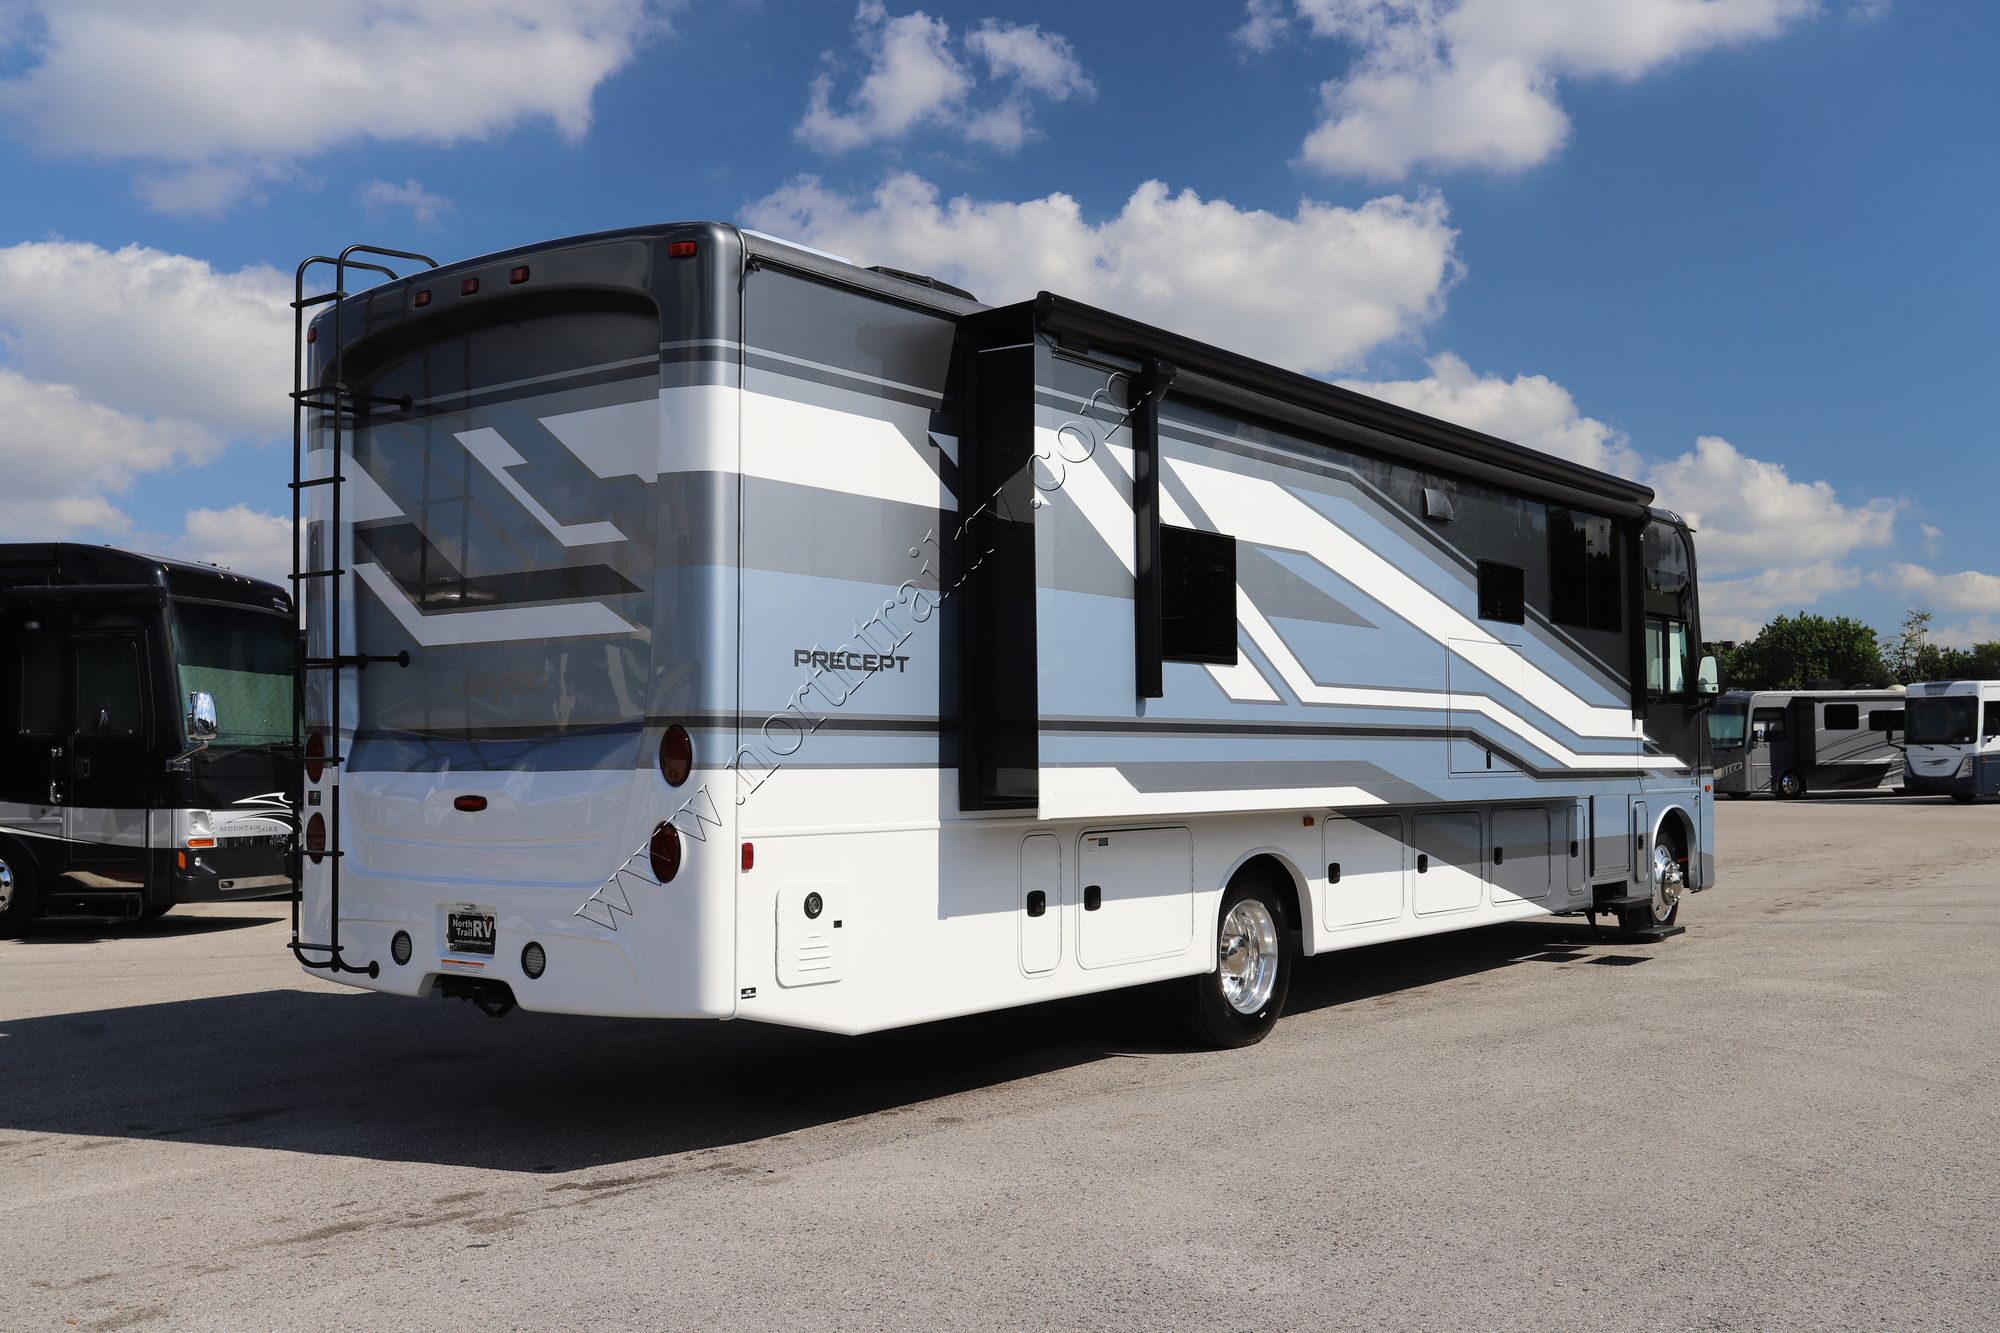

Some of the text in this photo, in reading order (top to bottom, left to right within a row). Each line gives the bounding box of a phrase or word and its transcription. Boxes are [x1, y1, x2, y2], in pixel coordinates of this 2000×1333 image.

[794, 648, 911, 673] PRECEPT
[453, 919, 473, 928] North
[473, 920, 493, 938] RV
[456, 928, 473, 937] Trail
